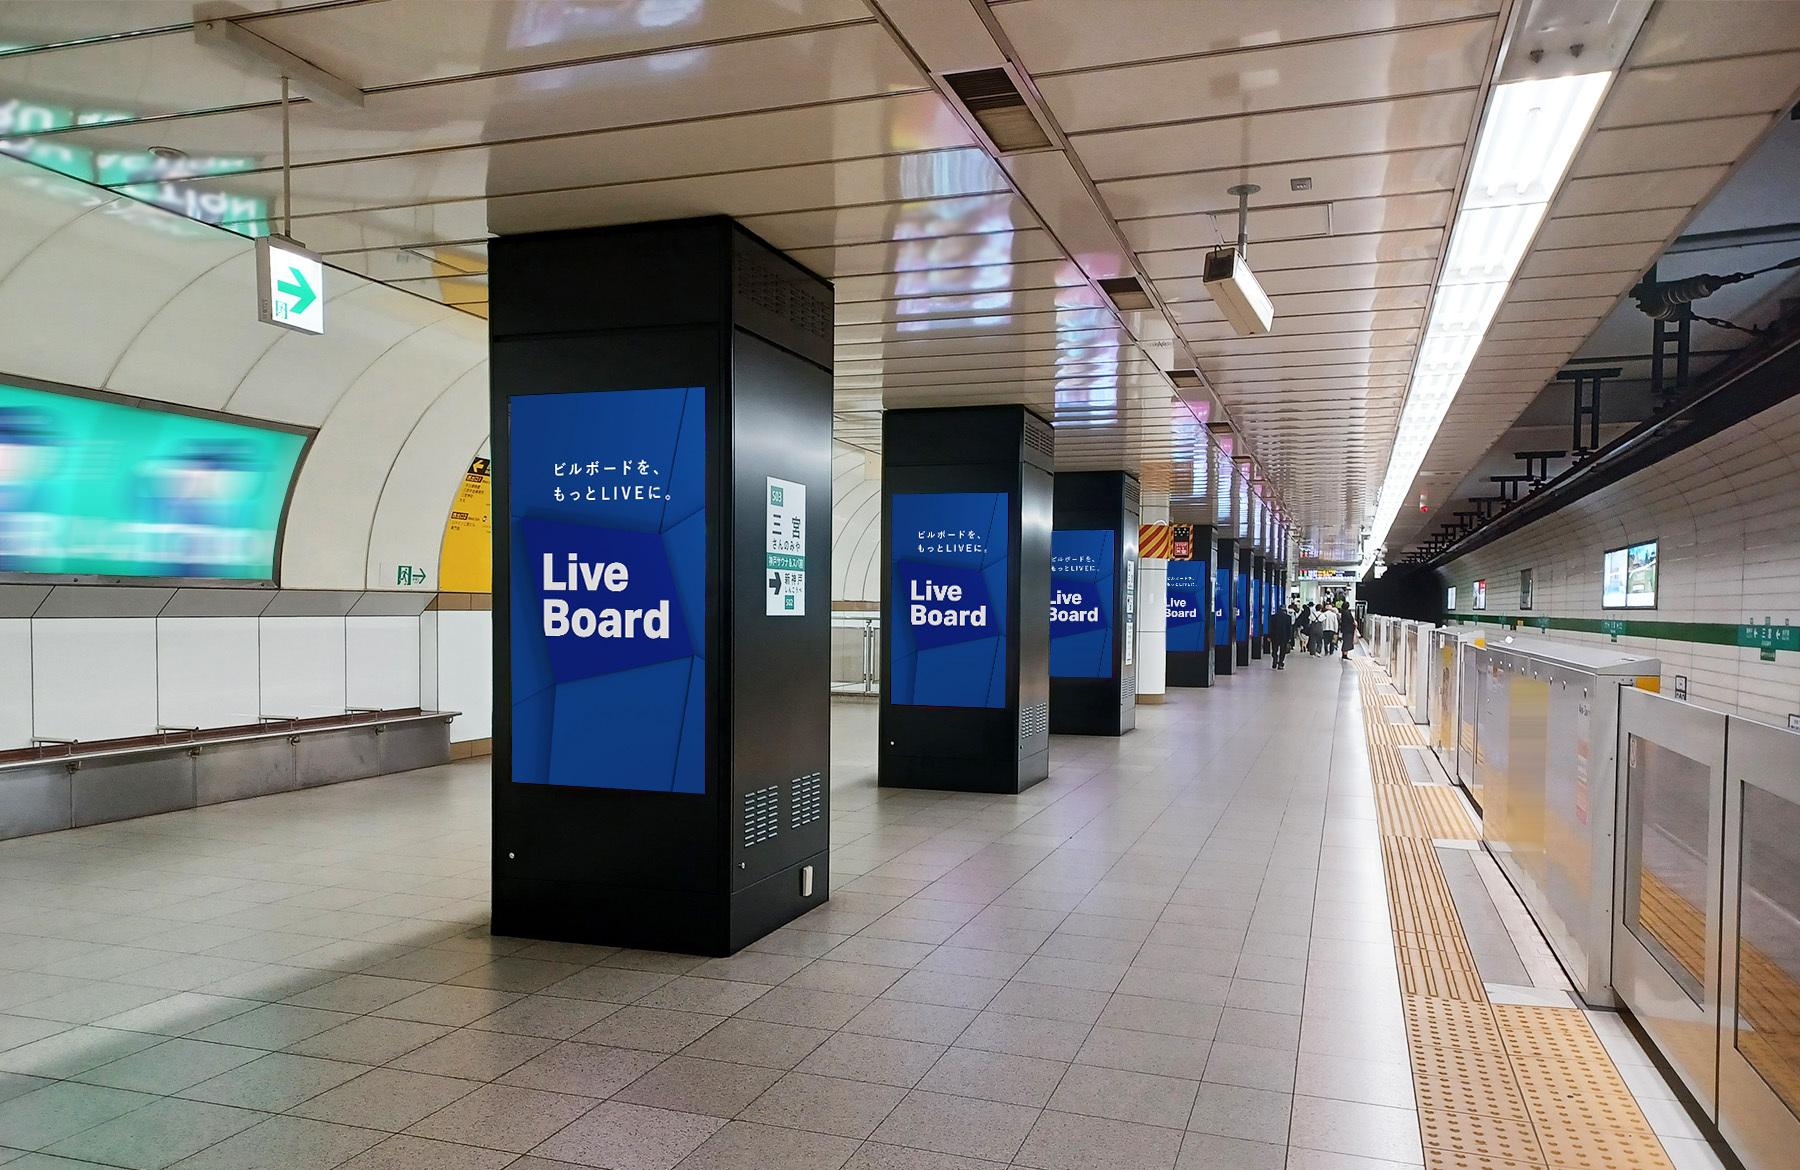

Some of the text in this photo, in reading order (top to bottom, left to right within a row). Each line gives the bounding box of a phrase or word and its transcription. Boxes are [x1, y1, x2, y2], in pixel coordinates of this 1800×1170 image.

[553, 459, 660, 476] ビルボードを、
[553, 485, 672, 502] もっとLIVEに。
[772, 513, 801, 539] 三宮
[917, 530, 982, 540] ビルボードを、
[772, 539, 801, 552] さんのみや
[542, 552, 629, 593] Live
[910, 579, 963, 601] Live
[542, 598, 670, 639] Board
[910, 604, 987, 627] Board
